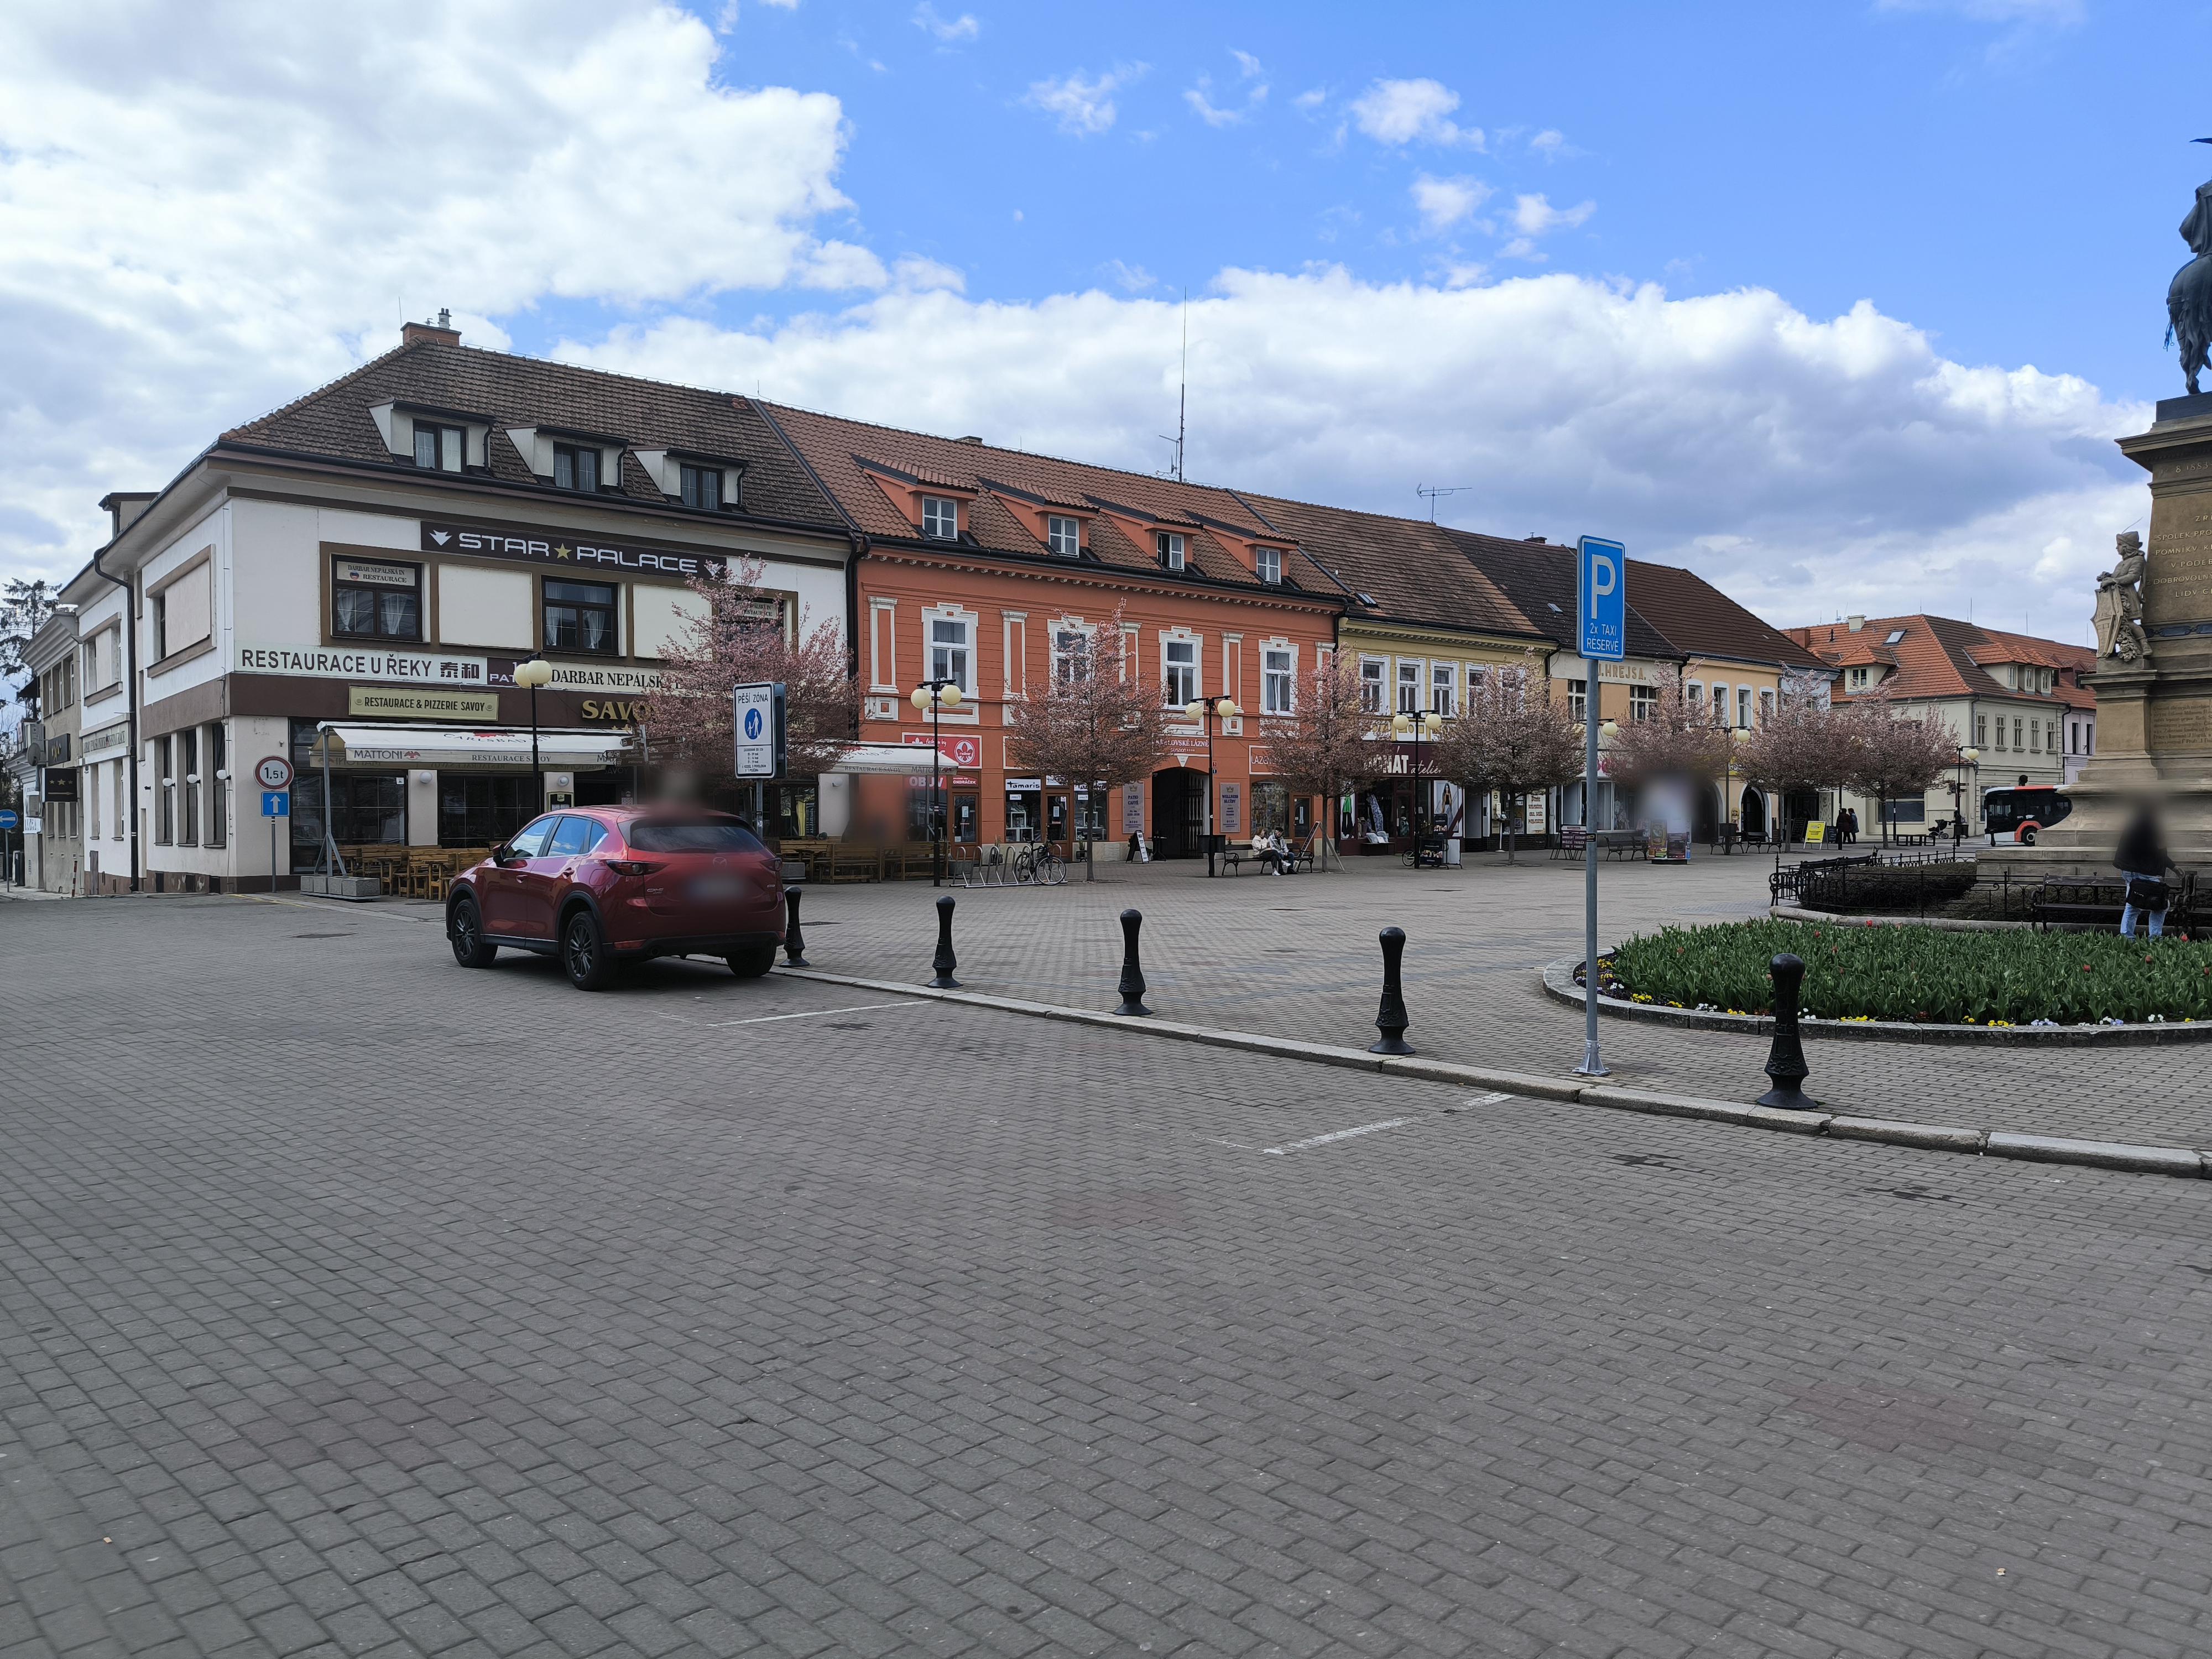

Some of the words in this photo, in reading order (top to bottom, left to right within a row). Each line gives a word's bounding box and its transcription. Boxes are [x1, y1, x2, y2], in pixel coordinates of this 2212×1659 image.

[2157, 532, 2190, 541] SPOLEK
[458, 533, 549, 556] STAR
[577, 546, 698, 573] PALACE
[348, 564, 370, 572] DARBAR
[363, 574, 407, 583] RESTAURACE
[1591, 554, 1616, 619] P
[1590, 623, 1598, 634] 2x
[1601, 624, 1616, 637] TAXI
[242, 649, 366, 673] RESTAURACE
[371, 657, 380, 674] U
[387, 654, 432, 676] ŘEKY
[489, 673, 515, 683] PAT
[551, 669, 604, 685] DARBAR
[607, 672, 664, 689] NEPÁLSK
[364, 697, 415, 708] RESTAURACE
[416, 700, 422, 709] &
[424, 699, 458, 710] PIZZERIE
[461, 701, 486, 712] SAVOY
[738, 692, 751, 704] PĚŠÍ
[753, 692, 769, 703] ZÓNA
[582, 700, 658, 721] SAVO
[1191, 739, 1209, 747] LÁZNĚ
[354, 750, 403, 759] MATTONI
